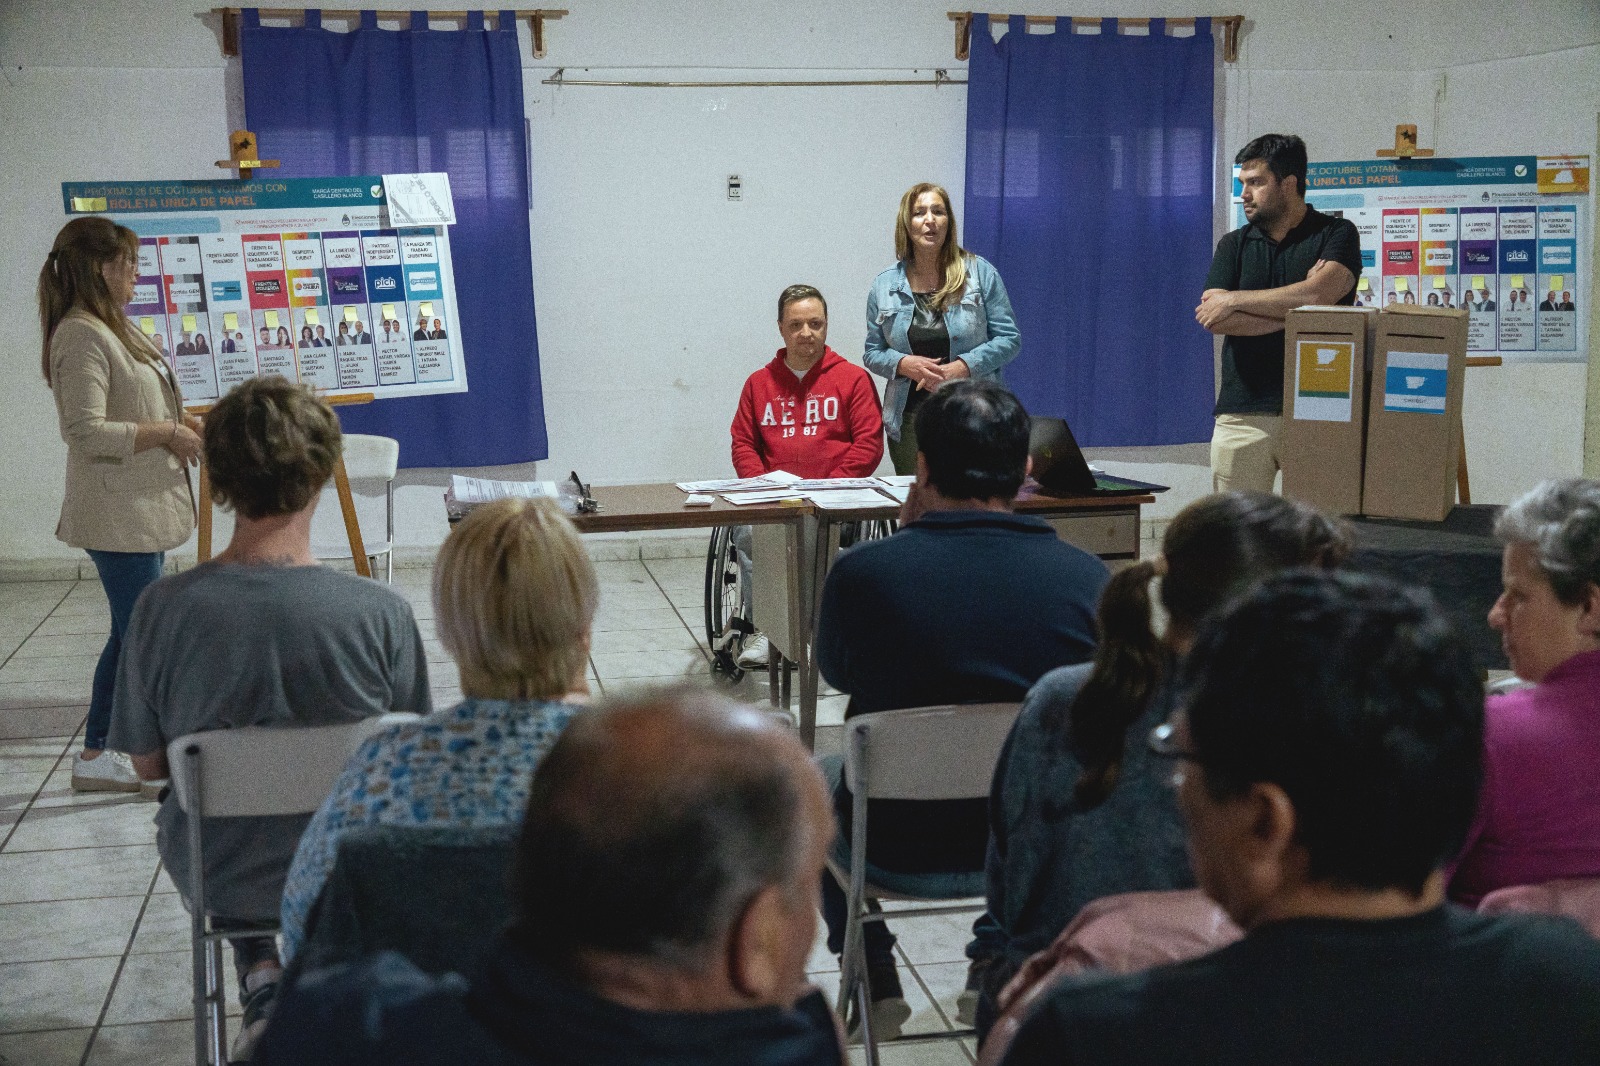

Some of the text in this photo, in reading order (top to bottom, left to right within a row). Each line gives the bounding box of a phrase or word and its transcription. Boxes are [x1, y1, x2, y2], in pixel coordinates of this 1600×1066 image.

[1319, 166, 1362, 175] OCTUBRE
[1366, 175, 1401, 184] PAPEL
[135, 187, 147, 195] 26
[150, 186, 162, 195] DE
[166, 185, 214, 194] OCTUBRE
[217, 184, 263, 193] VOTAMOS
[266, 184, 287, 192] CON
[110, 199, 157, 209] BOLETA
[201, 197, 217, 206] DE
[220, 196, 256, 206] PAPEL
[1507, 250, 1528, 261] pich
[375, 277, 396, 288] pich
[761, 397, 838, 426] AERO
